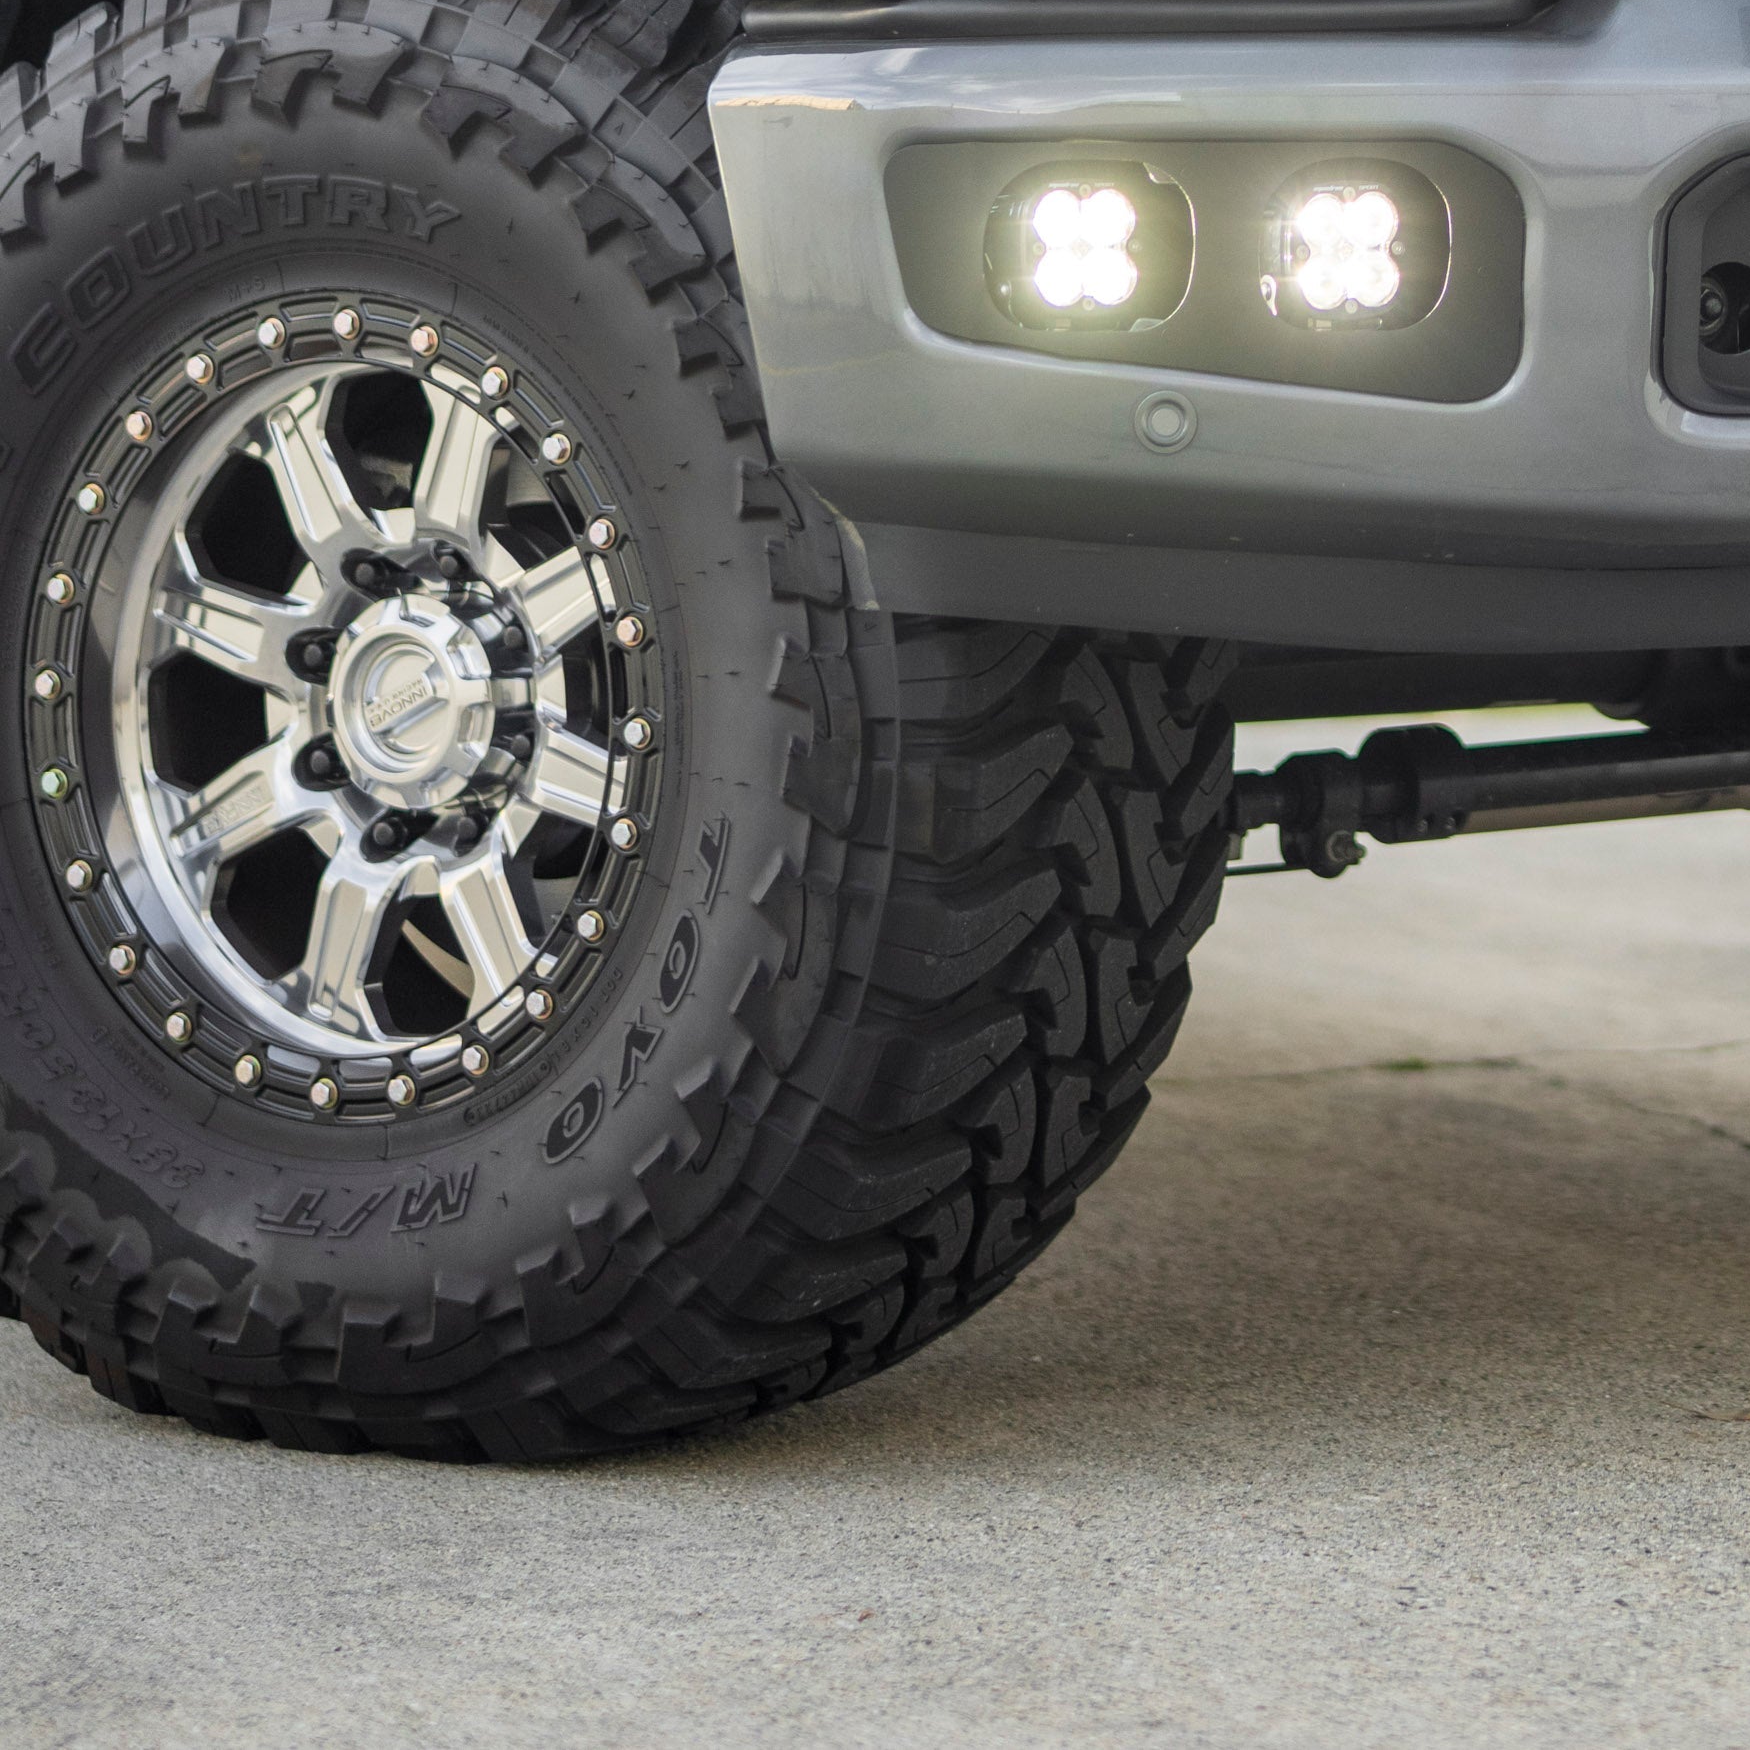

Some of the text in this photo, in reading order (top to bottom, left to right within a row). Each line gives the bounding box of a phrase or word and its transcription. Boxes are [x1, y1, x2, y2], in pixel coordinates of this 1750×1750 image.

[11, 174, 462, 398] COUNTRY
[542, 811, 732, 1165] TOYO
[256, 1161, 478, 1237] M/T
